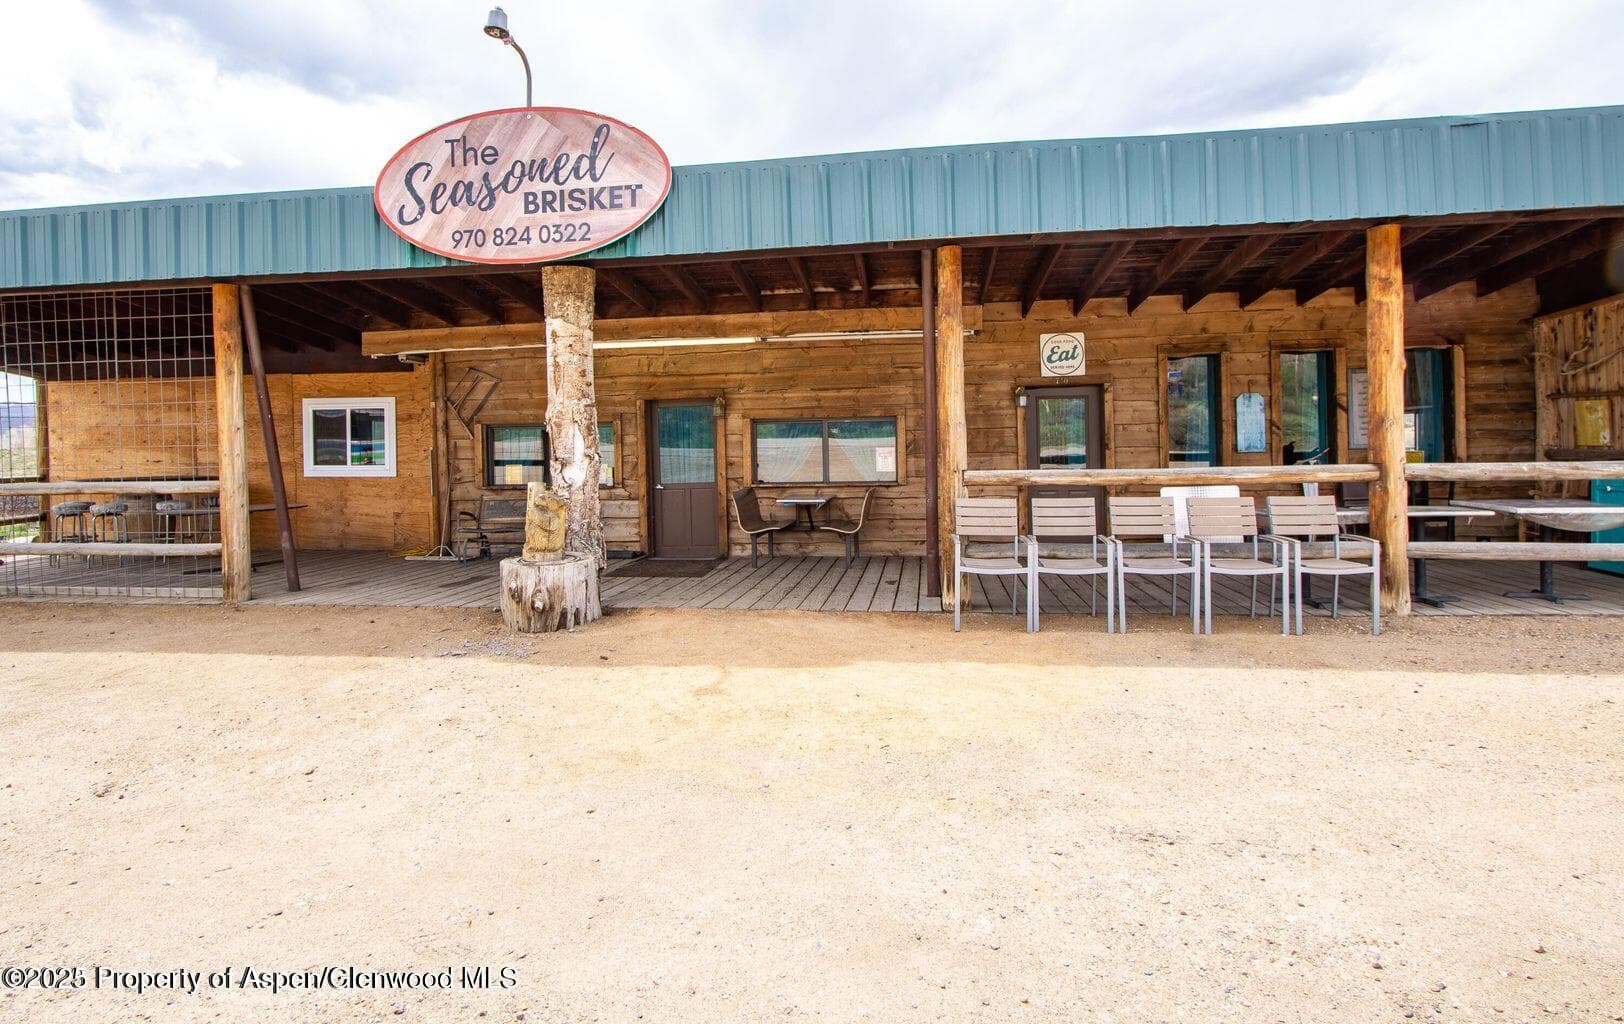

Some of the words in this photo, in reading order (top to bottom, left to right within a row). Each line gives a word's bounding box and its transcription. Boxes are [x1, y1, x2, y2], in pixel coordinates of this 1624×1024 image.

[445, 136, 499, 168] The
[398, 123, 615, 226] Seasoned
[523, 184, 643, 215] BRISKET
[452, 229, 486, 249] 970
[492, 226, 532, 246] 824
[538, 222, 591, 244] 0322
[1047, 344, 1079, 364] Eat
